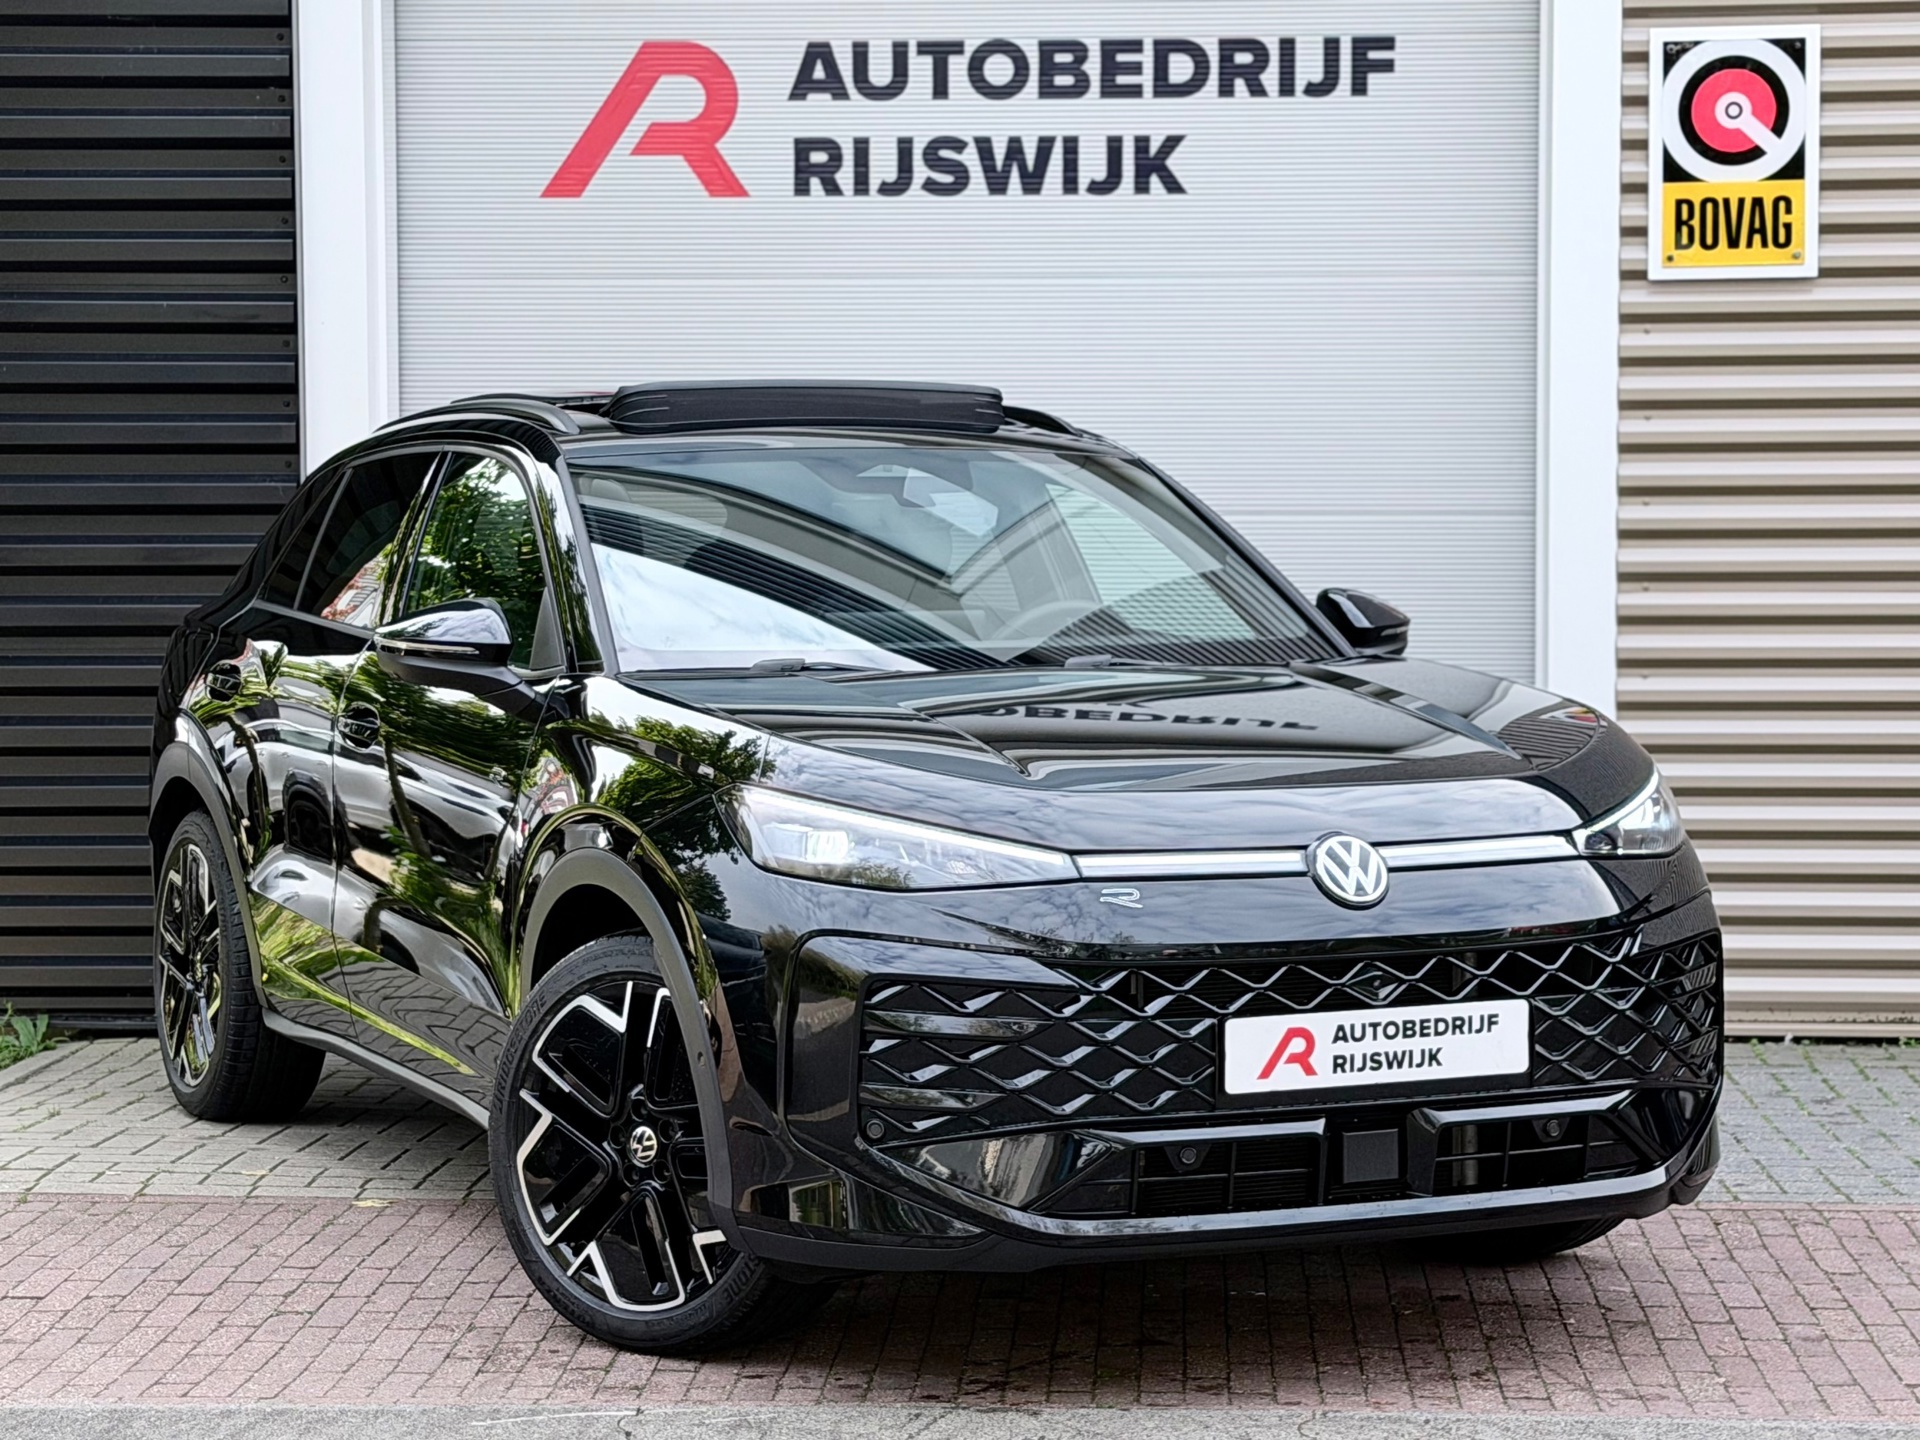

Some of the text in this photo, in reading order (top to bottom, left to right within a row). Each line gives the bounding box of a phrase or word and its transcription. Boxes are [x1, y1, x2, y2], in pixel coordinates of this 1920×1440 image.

[788, 36, 1397, 101] AUTOBEDRIJF
[793, 134, 1188, 198] RIJSWIJK
[1674, 194, 1793, 251] BOVAG
[1100, 888, 1144, 909] R
[1331, 1012, 1500, 1045] AUTOBEDRIJF
[1331, 1046, 1444, 1075] RIJSWIJK
